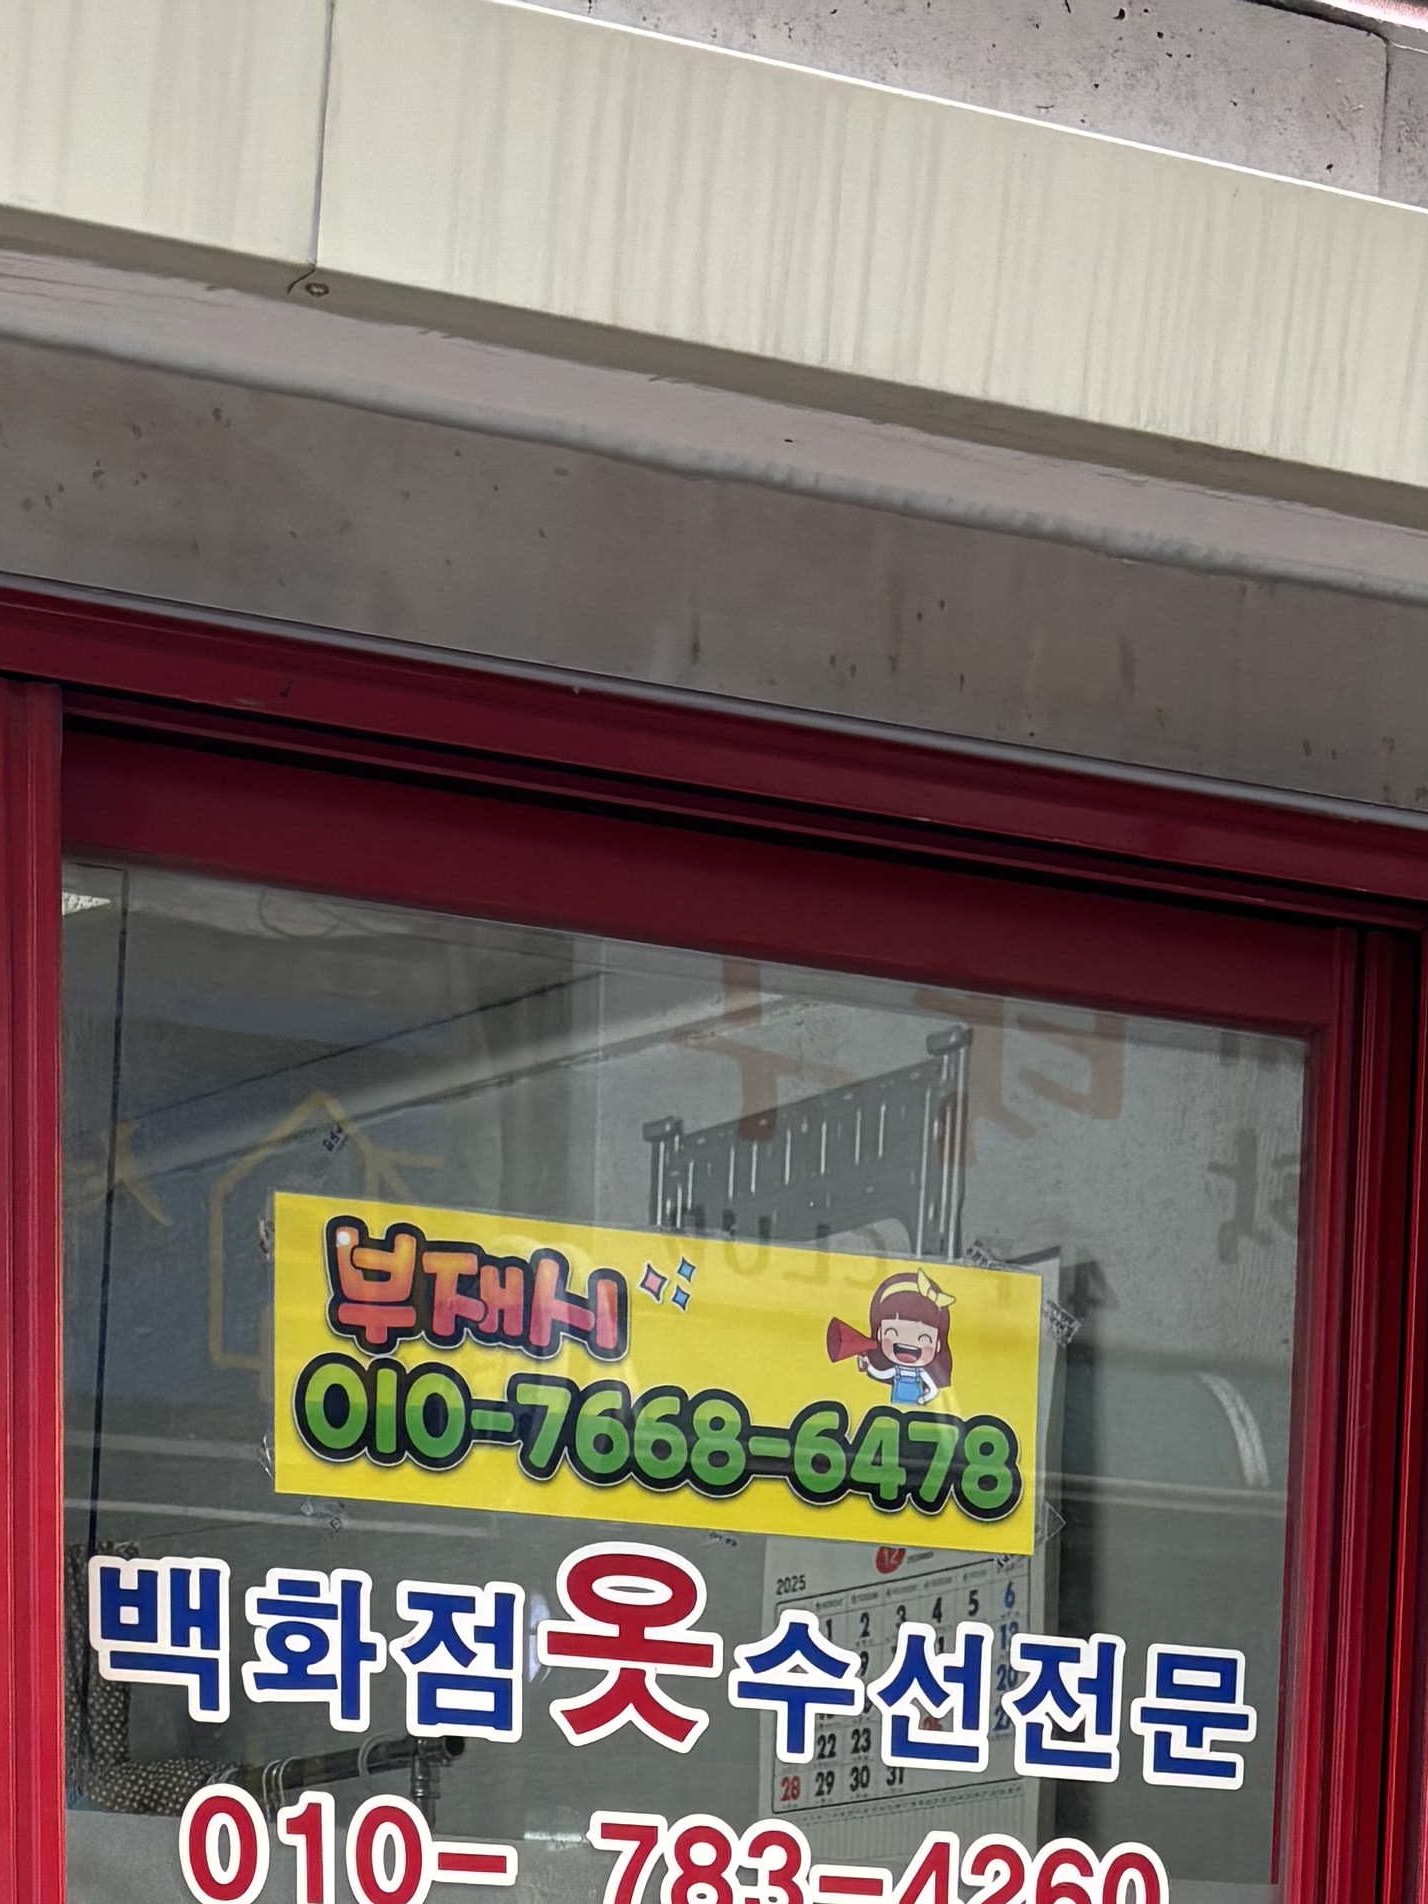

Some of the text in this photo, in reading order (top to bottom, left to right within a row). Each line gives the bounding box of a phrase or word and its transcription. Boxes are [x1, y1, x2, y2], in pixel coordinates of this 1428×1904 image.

[325, 1214, 628, 1359] 부재시
[295, 1353, 1024, 1520] 010-7668-6478
[775, 1574, 807, 1596] 2025
[858, 1611, 871, 1639] 2
[931, 1596, 943, 1624] 4
[968, 1589, 979, 1617] 5
[1004, 1580, 1015, 1608] 6
[817, 1726, 871, 1760] 22 23
[780, 1774, 801, 1801] 28
[814, 1771, 836, 1797] 29
[848, 1765, 870, 1791] 30
